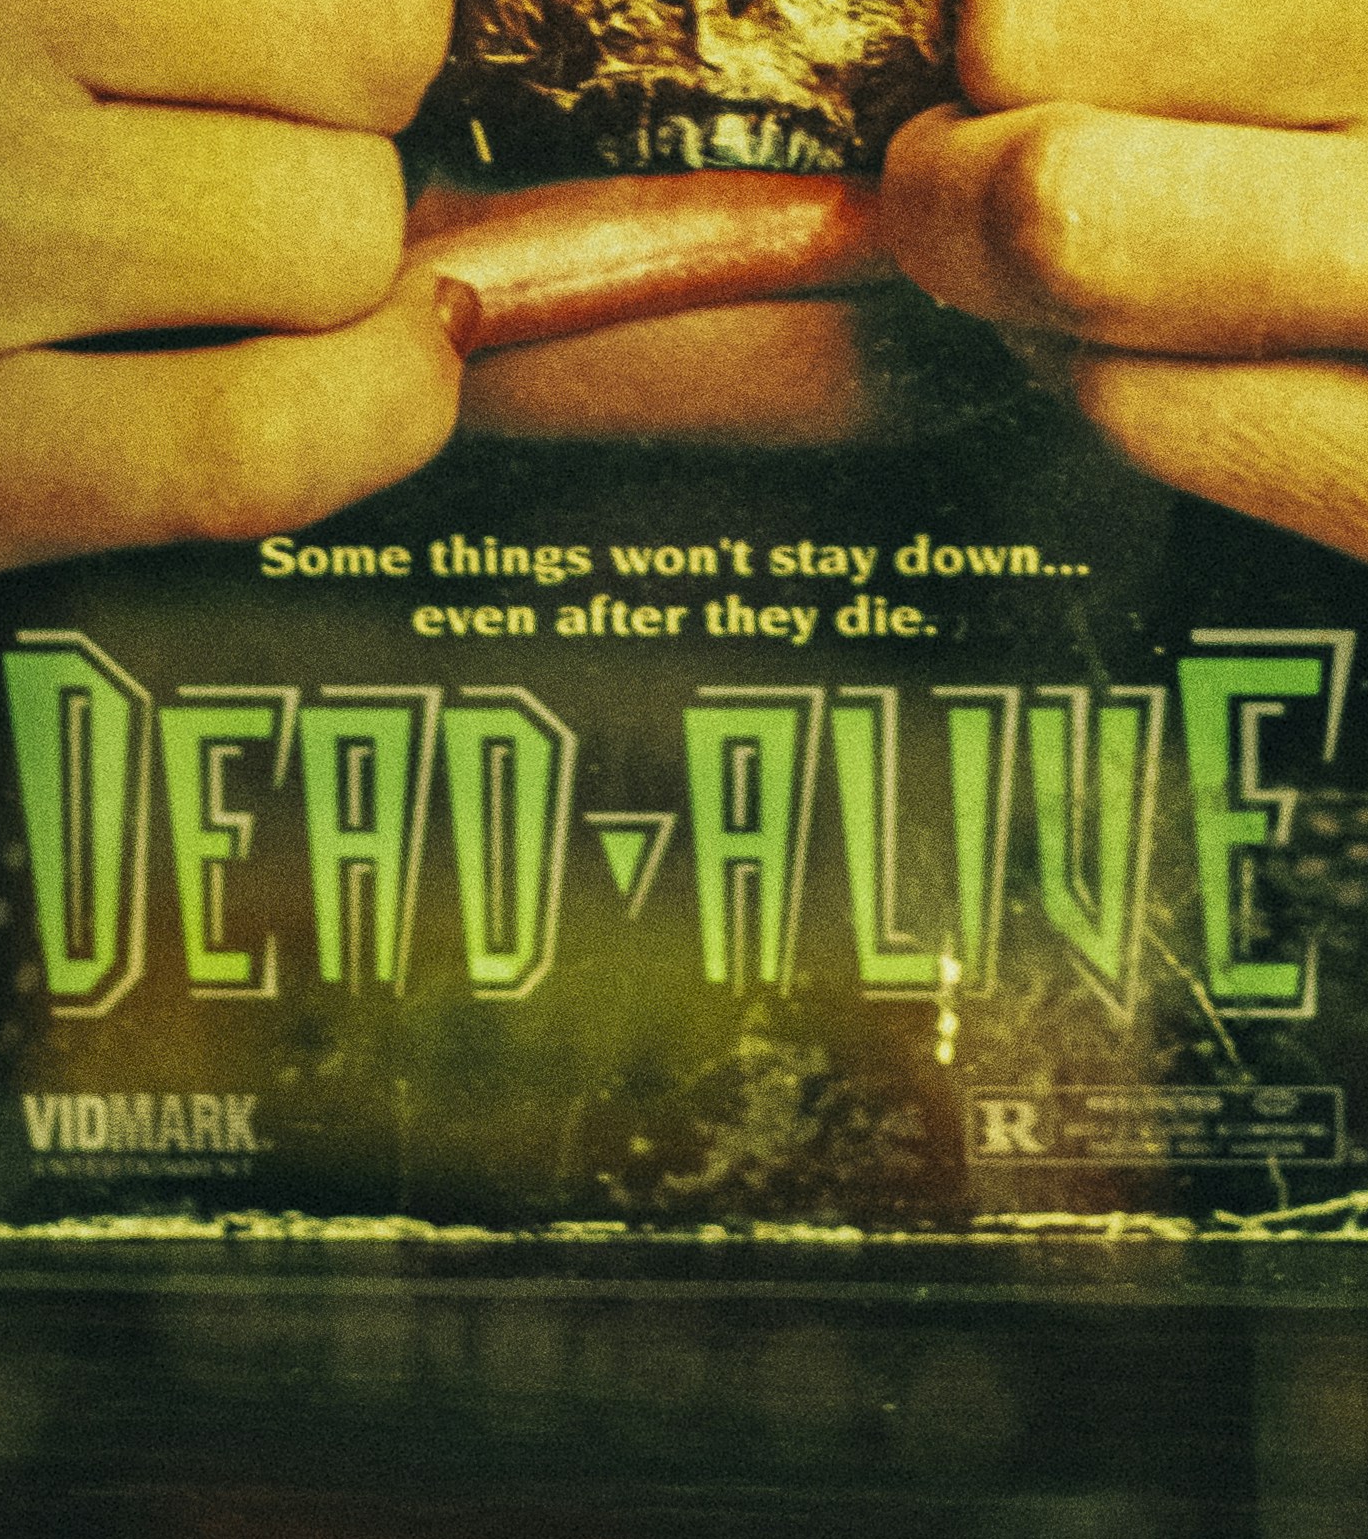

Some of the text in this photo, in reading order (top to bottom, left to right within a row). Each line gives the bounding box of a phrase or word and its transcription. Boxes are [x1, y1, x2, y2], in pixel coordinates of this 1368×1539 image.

[259, 534, 1091, 584] Some things won't stay down...
[411, 594, 938, 646] even after they die.
[22, 1093, 258, 1152] VIDMARK
[975, 1099, 1047, 1154] R
